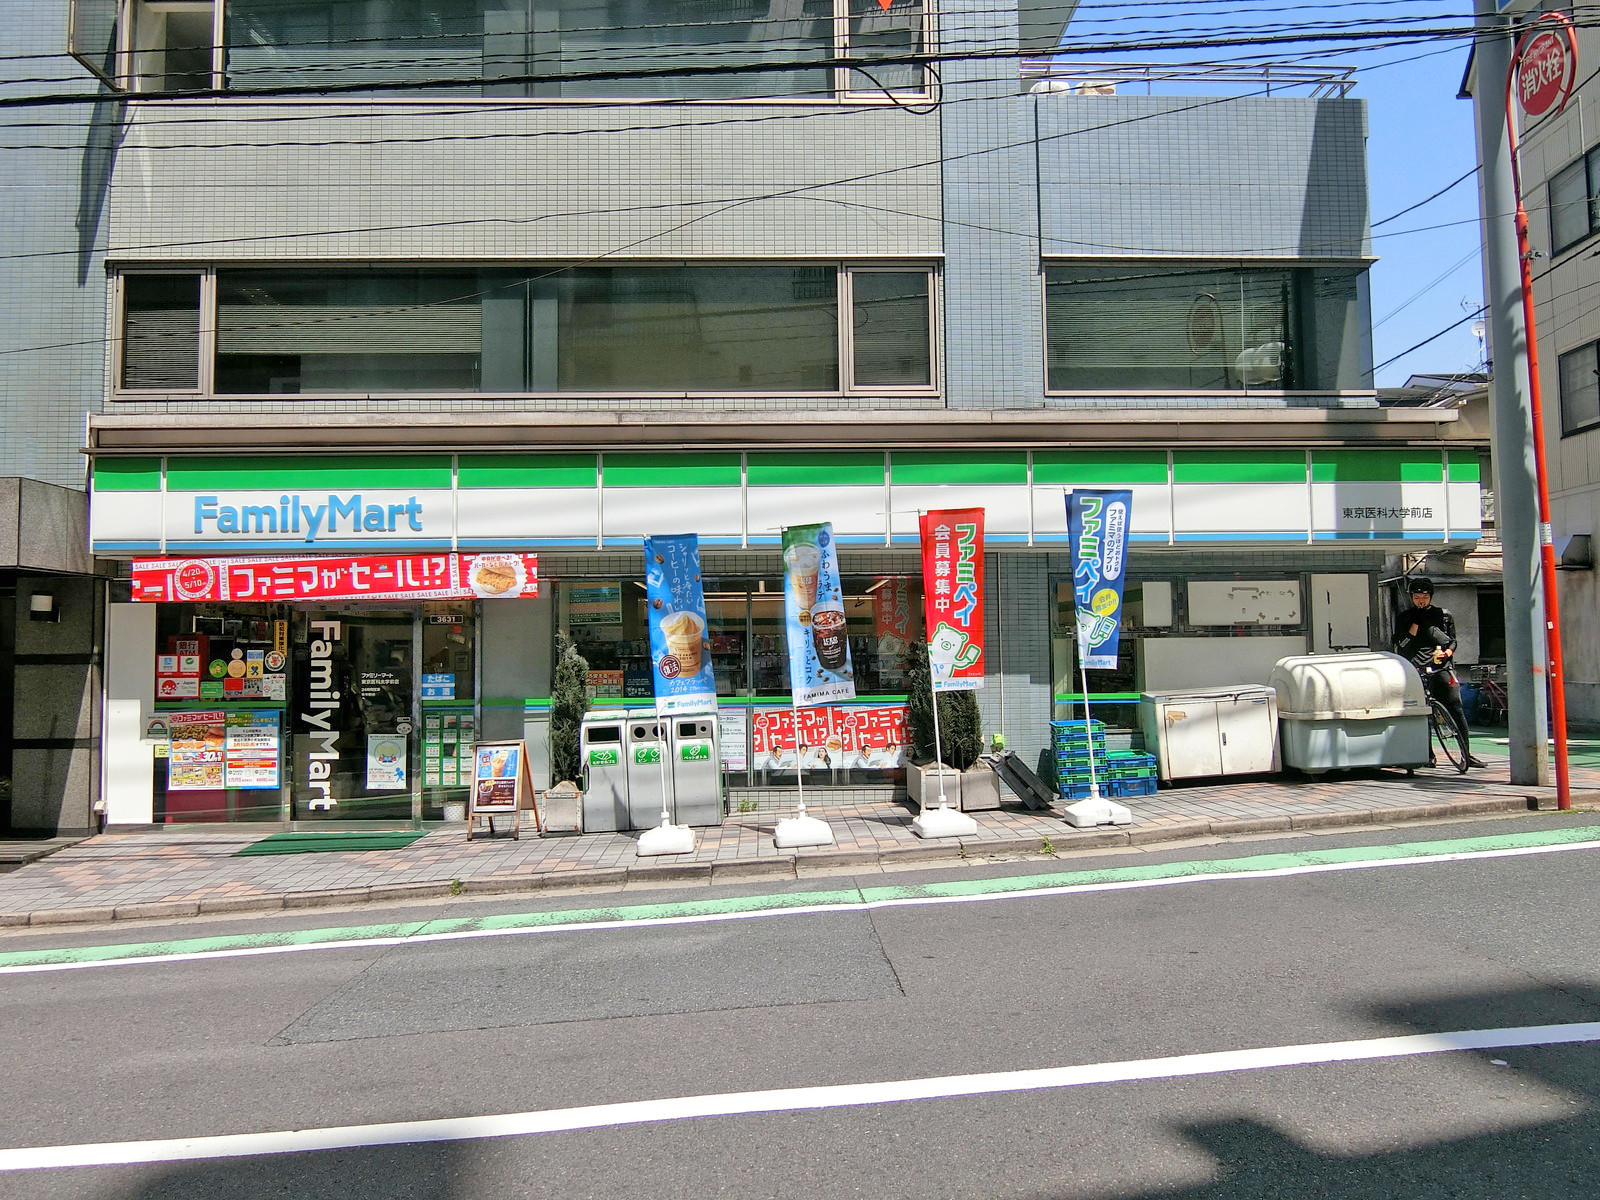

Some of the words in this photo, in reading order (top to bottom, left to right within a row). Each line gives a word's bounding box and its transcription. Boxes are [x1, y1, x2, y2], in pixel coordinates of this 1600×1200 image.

[1522, 47, 1561, 103] 消火栓
[194, 495, 423, 543] FamilyMart
[1343, 507, 1433, 519] 東京医科大学前店
[1075, 497, 1103, 604] ファミペイ
[1105, 509, 1118, 573] ファミマのアプリ
[184, 579, 202, 589] 5/10
[233, 557, 446, 598] ファミマがセール!?
[667, 545, 684, 611] コーヒーの味わい
[678, 543, 693, 604] シャリッと冷たい
[820, 550, 832, 592] ふわうま
[934, 524, 951, 613] 会員募集中
[953, 523, 978, 627] ファミペイ
[818, 580, 825, 600] ラテ
[662, 660, 679, 676] 復活
[803, 628, 813, 684] キリっとコク
[427, 675, 450, 683] たばこ
[427, 687, 451, 696] お酒
[669, 677, 708, 687] カフェフラッペ
[670, 685, 688, 693] 2014
[677, 699, 713, 707] FamilyMart
[803, 691, 830, 700] FAMIMA
[301, 620, 341, 811] FamilyMart
[767, 710, 828, 731] ファミマが
[769, 727, 828, 748] セール!?
